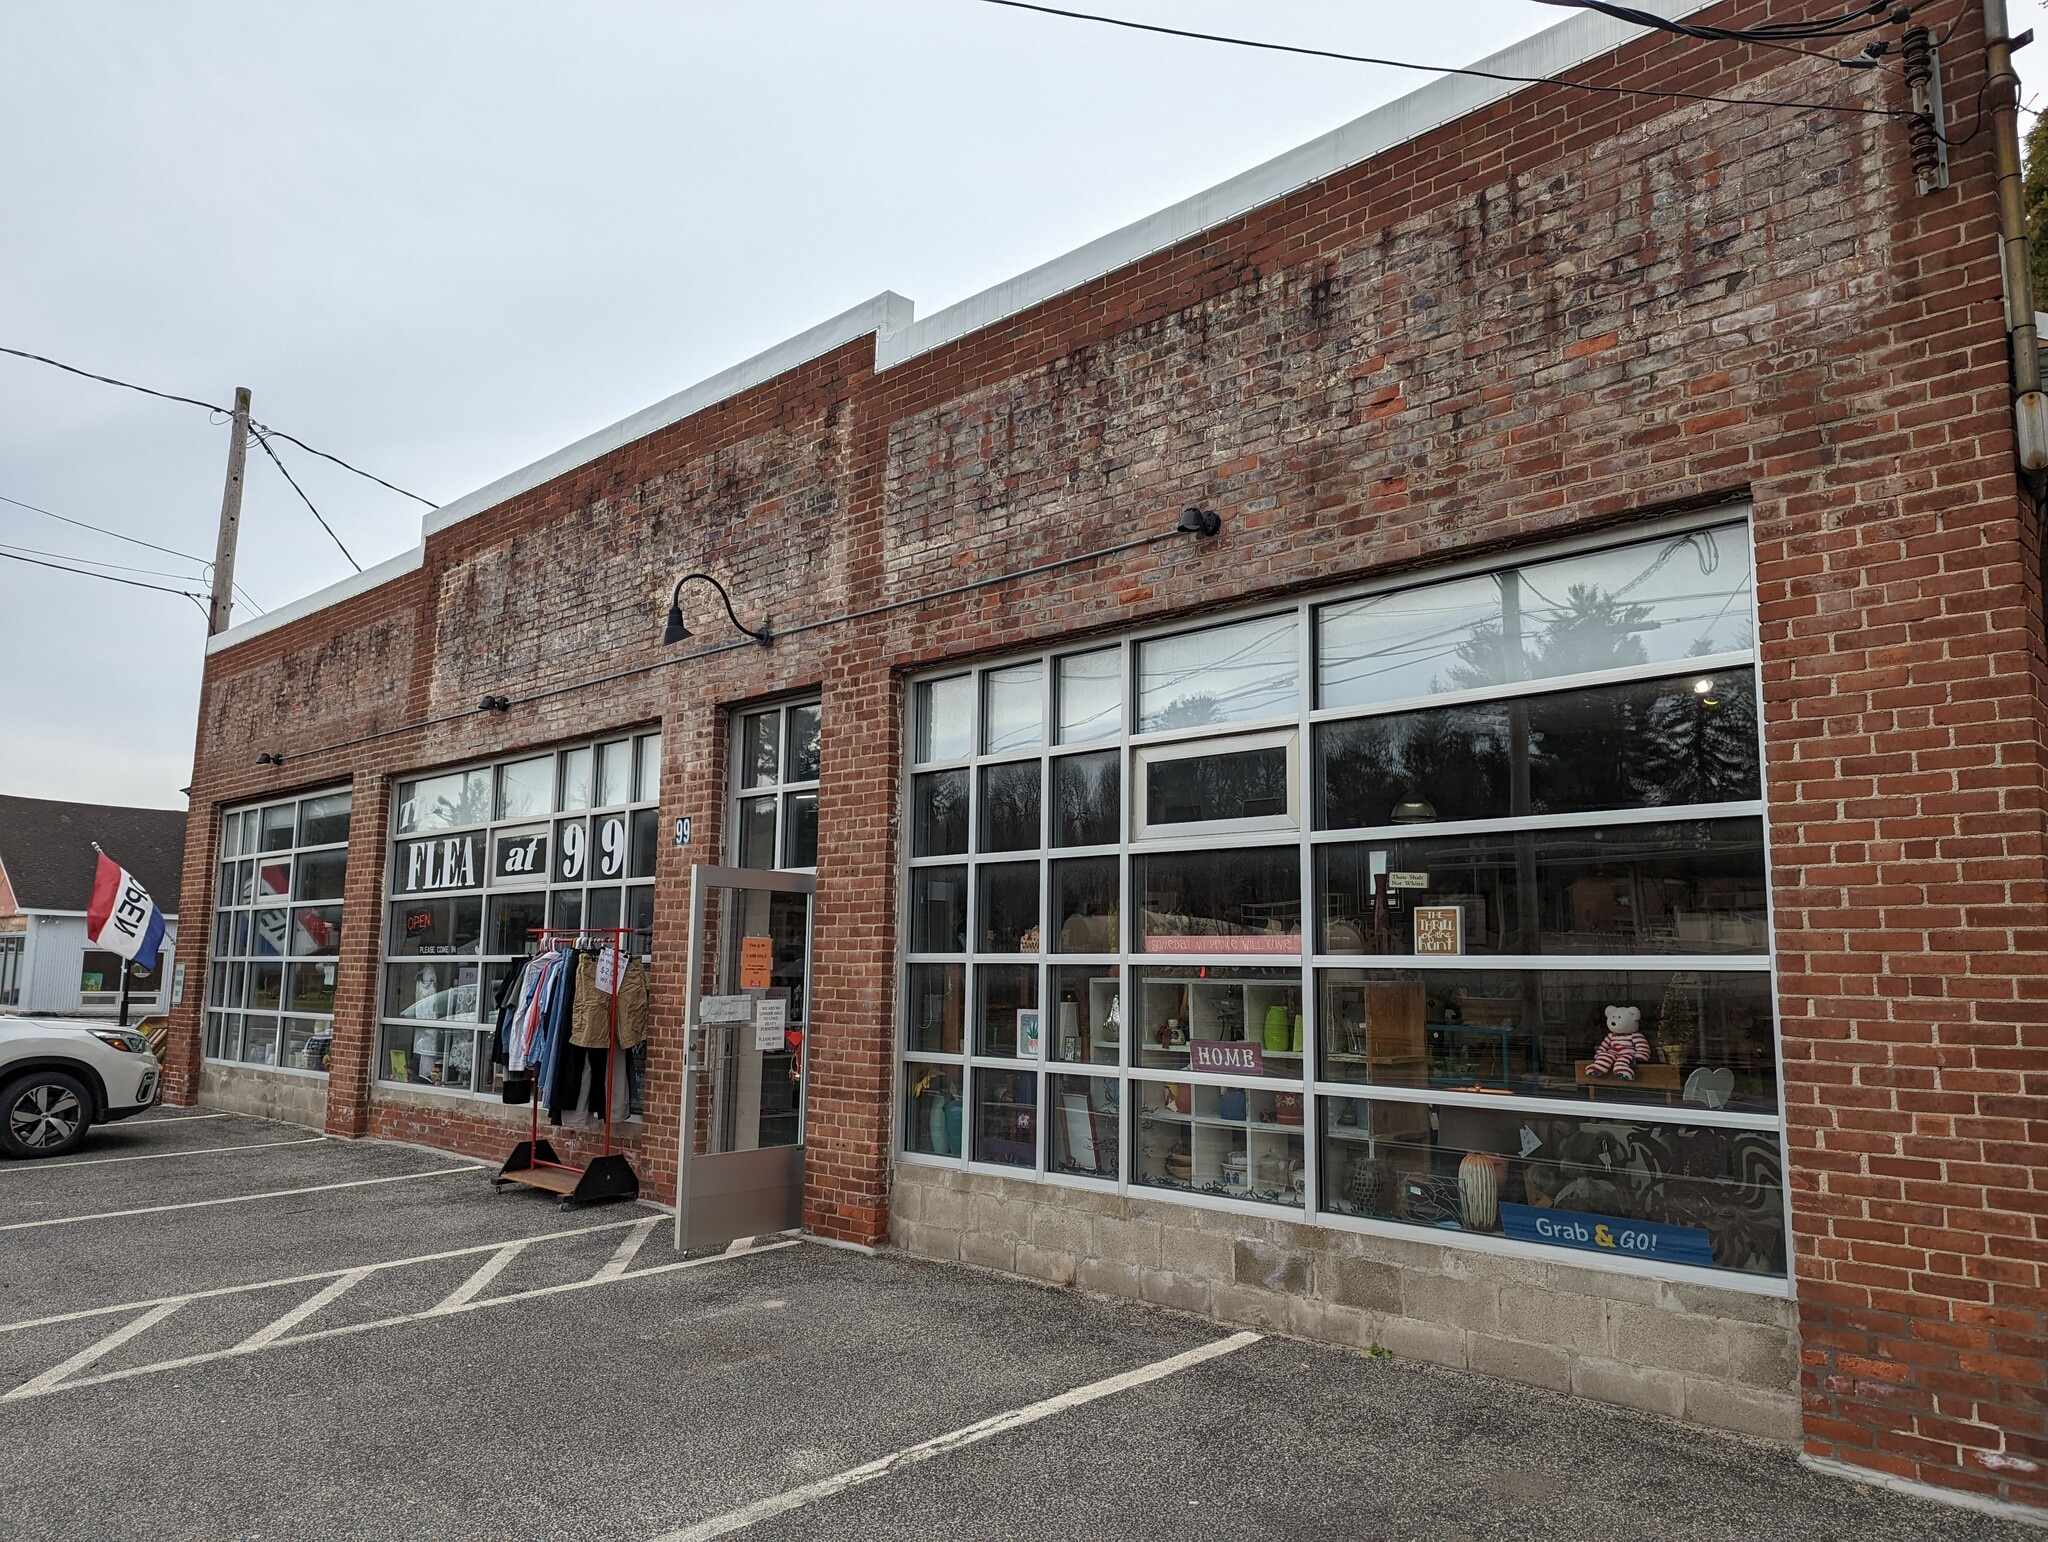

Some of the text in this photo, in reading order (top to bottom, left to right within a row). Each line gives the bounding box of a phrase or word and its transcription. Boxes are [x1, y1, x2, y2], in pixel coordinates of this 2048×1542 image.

[676, 819, 690, 844] 99
[406, 836, 475, 891] FLEA
[505, 838, 538, 872] at
[407, 913, 431, 930] OPEN
[1427, 911, 1444, 919] THE
[1418, 919, 1455, 931] THRILL
[1435, 930, 1455, 939] the
[420, 946, 436, 954] PLEASE
[1242, 940, 1264, 950] WILL
[1418, 936, 1455, 951] hunt
[1197, 1046, 1255, 1068] HOME
[1535, 1217, 1658, 1252] Grab & GO!
